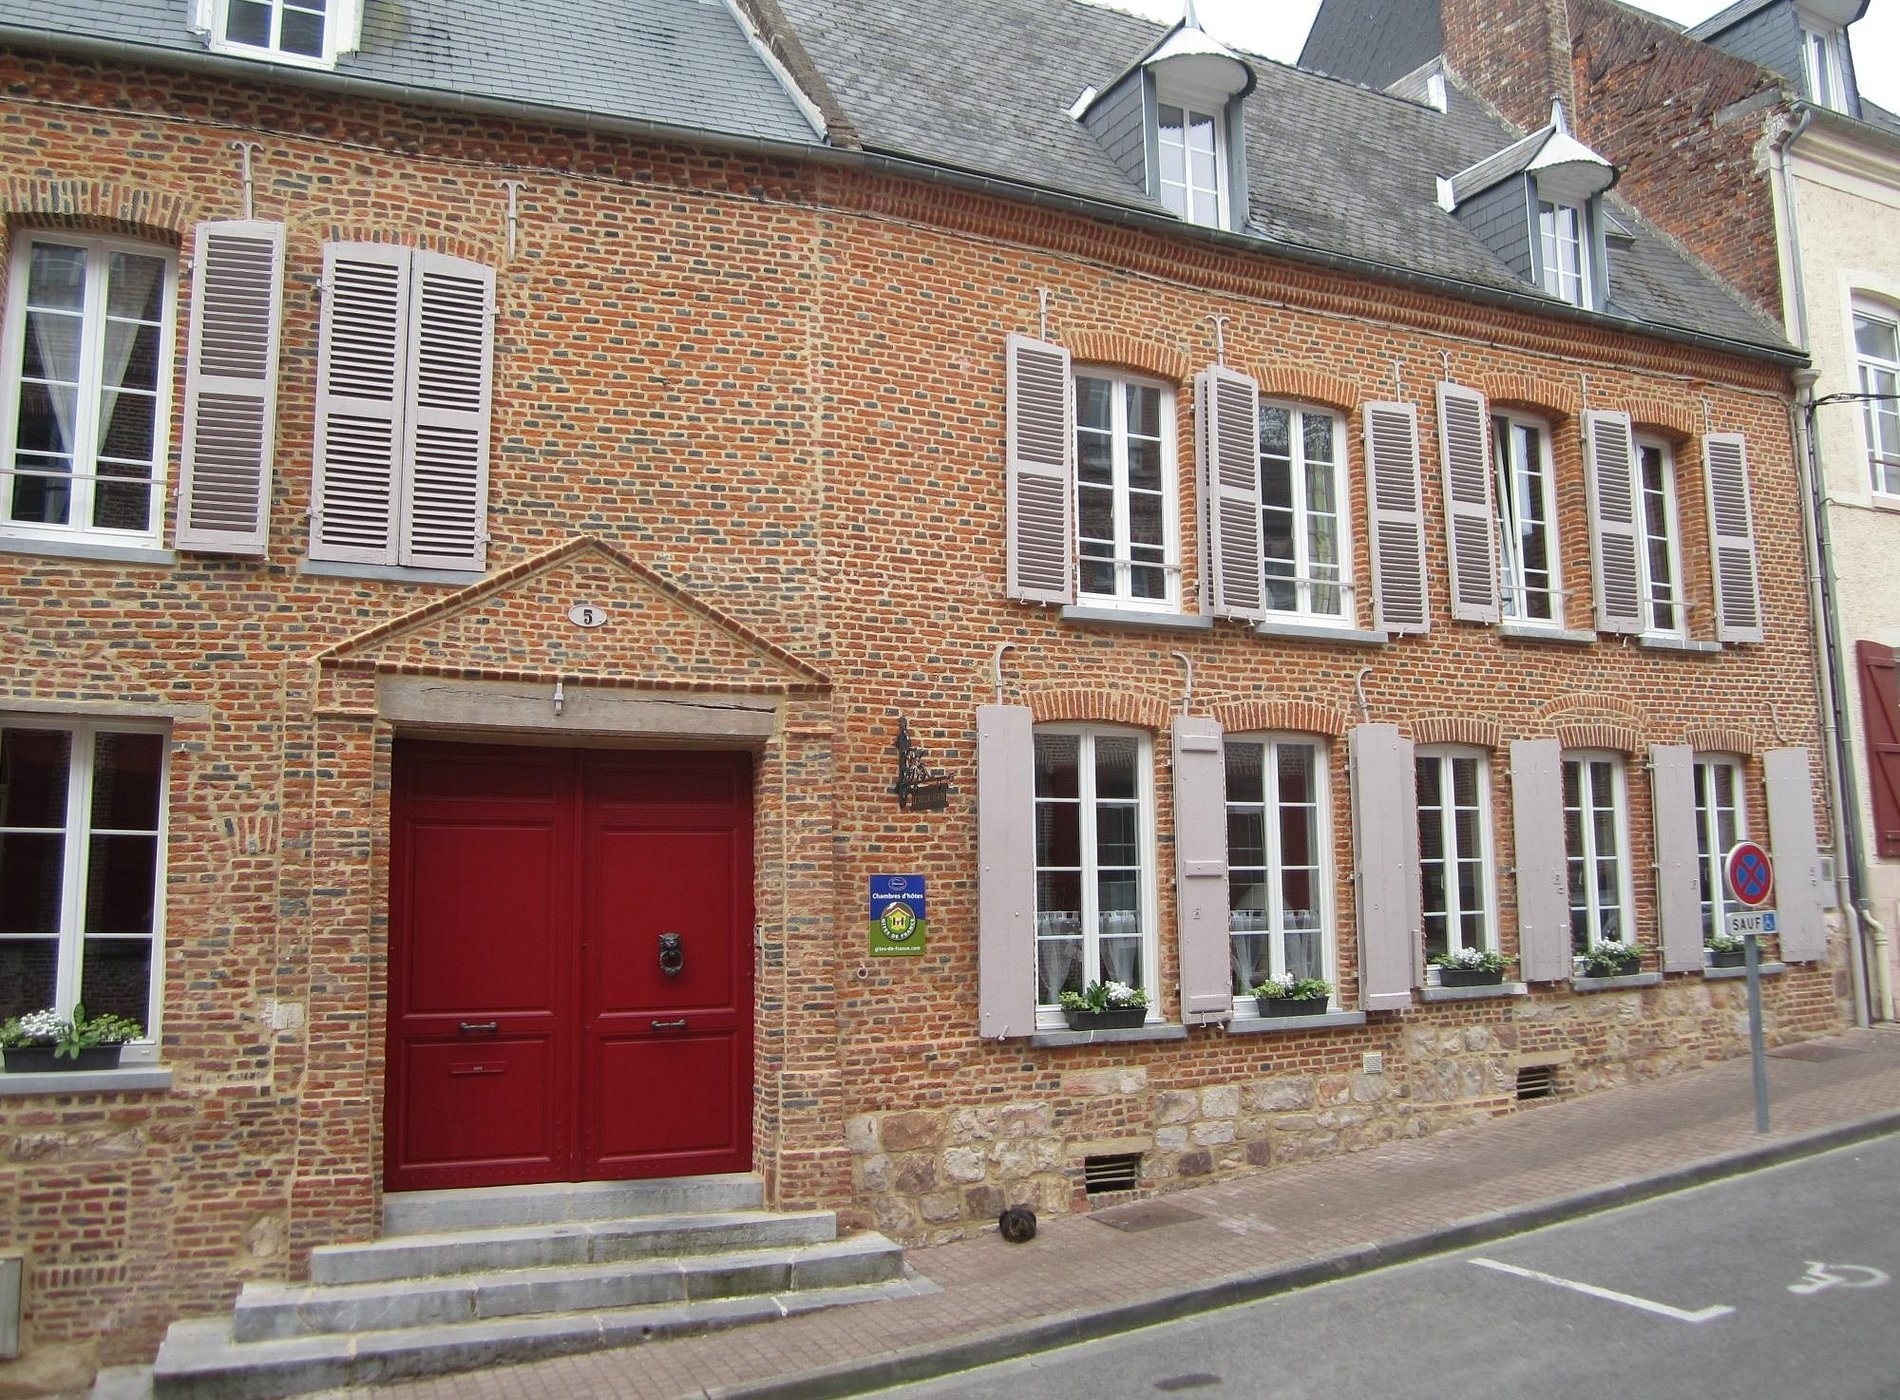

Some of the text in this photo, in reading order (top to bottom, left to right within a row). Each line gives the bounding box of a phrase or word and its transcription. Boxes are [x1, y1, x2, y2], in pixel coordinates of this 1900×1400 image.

[584, 609, 592, 625] 5
[901, 918, 915, 938] FRANCE
[1733, 917, 1760, 931] SAUF
